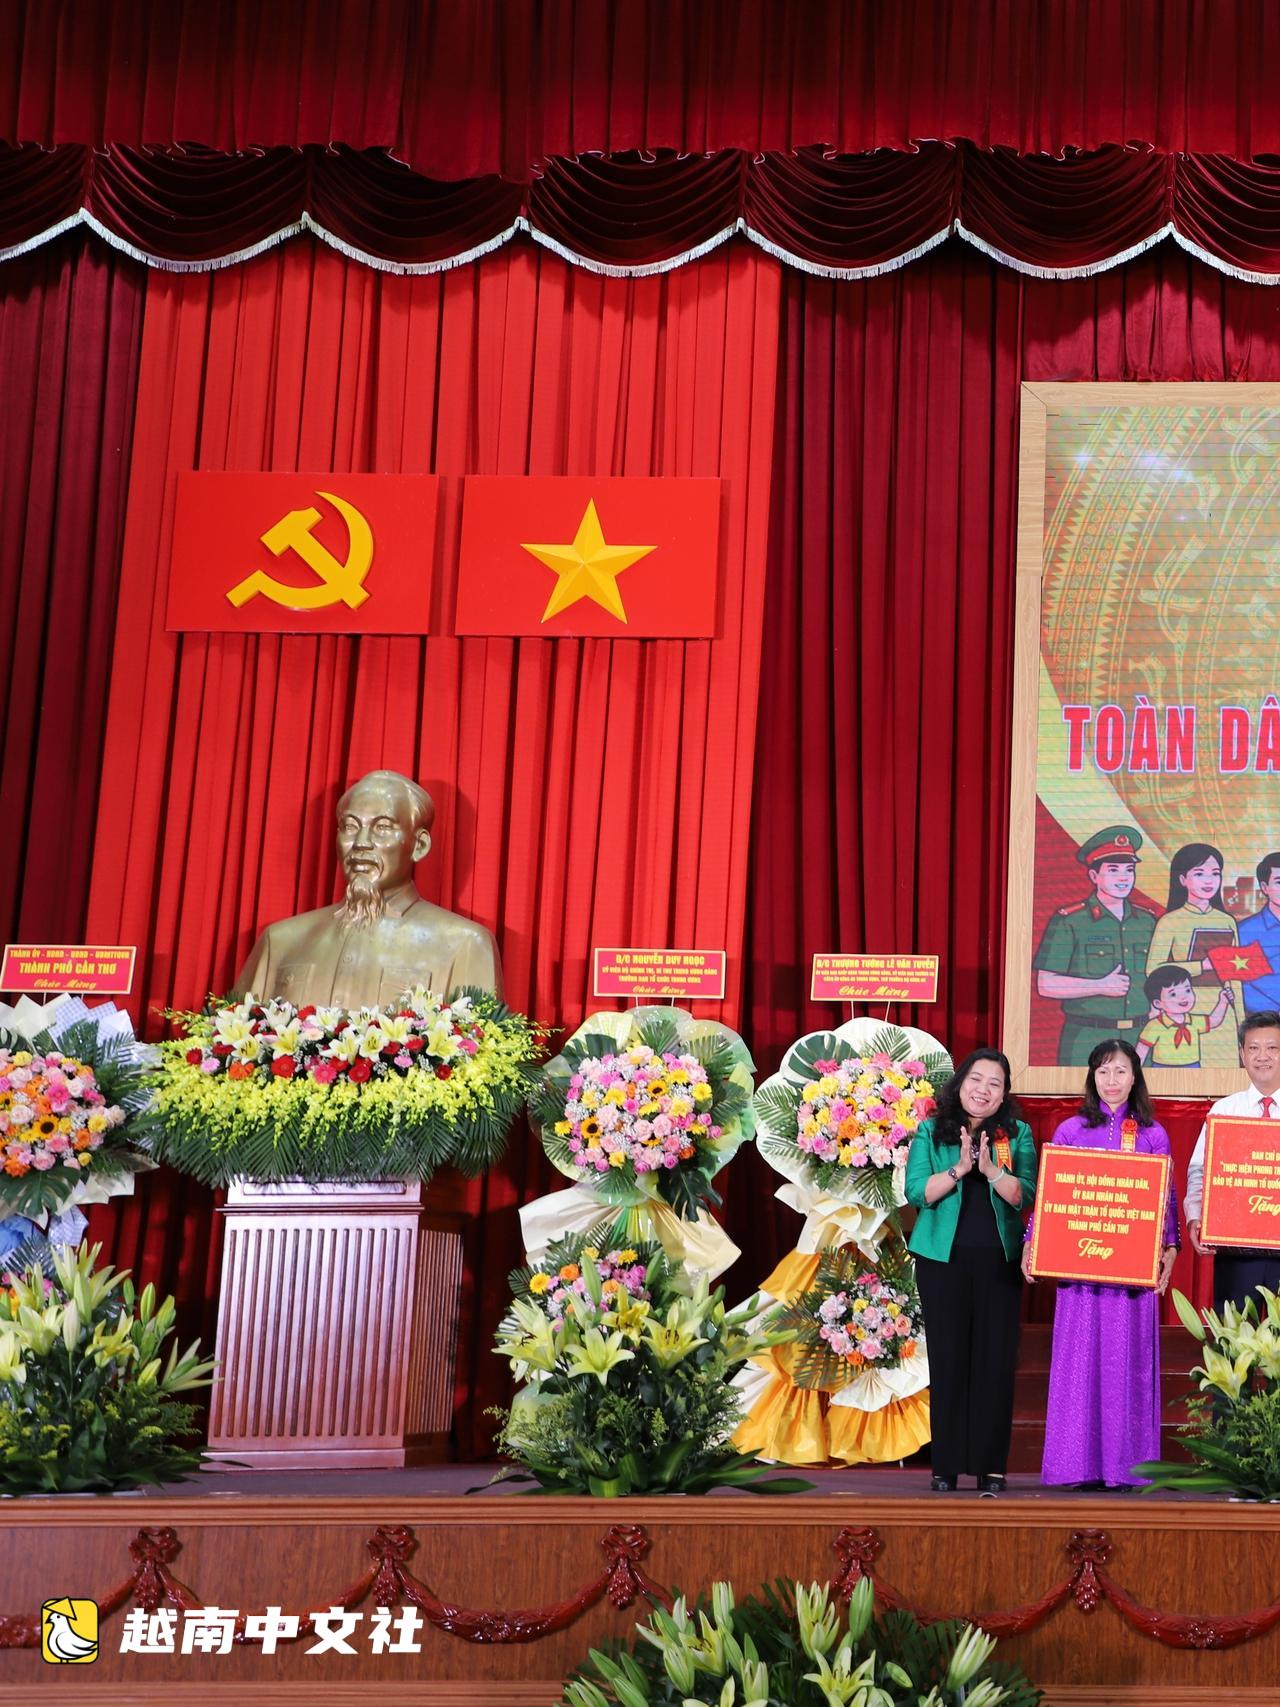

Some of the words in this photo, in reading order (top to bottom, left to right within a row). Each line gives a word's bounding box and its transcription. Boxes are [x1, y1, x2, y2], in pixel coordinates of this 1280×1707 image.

[1063, 695, 1195, 773] TOÀN
[20, 960, 51, 974] THÀNH
[53, 960, 73, 974] PHỐ
[75, 960, 95, 974] CẦN
[98, 962, 117, 975] THƠ
[633, 952, 664, 965] NGUYỄN
[666, 955, 682, 965] DUY
[683, 956, 705, 967] NGỌC
[1252, 1151, 1264, 1160] BAN
[1265, 1150, 1275, 1161] CHỈ
[1055, 1172, 1075, 1184] THÀNH
[1077, 1172, 1085, 1185] ỦY,
[1086, 1175, 1097, 1188] HỘI
[1098, 1174, 1115, 1187] ĐỒNG
[1116, 1176, 1134, 1188] NHÂN
[1135, 1177, 1150, 1190] DÂN,
[1072, 1187, 1081, 1199] ỦY
[1082, 1191, 1095, 1200] BAN
[1096, 1190, 1114, 1202] NHÂN
[1115, 1191, 1129, 1204] DÂN,
[1044, 1200, 1052, 1213] ỦY
[1054, 1204, 1067, 1214] BAN
[1068, 1203, 1081, 1216] MẶT
[1082, 1204, 1099, 1218] TRẬN
[1100, 1204, 1108, 1218] TỔ
[1108, 1205, 1125, 1219] QUỐC
[1126, 1208, 1139, 1221] VIỆT
[1140, 1211, 1156, 1221] NAM
[1068, 1219, 1088, 1231] THÀNH
[1089, 1220, 1102, 1232] PHỐ
[1103, 1221, 1116, 1233] CẦN
[1117, 1224, 1129, 1234] THƠ
[1078, 1237, 1114, 1260] Tặng
